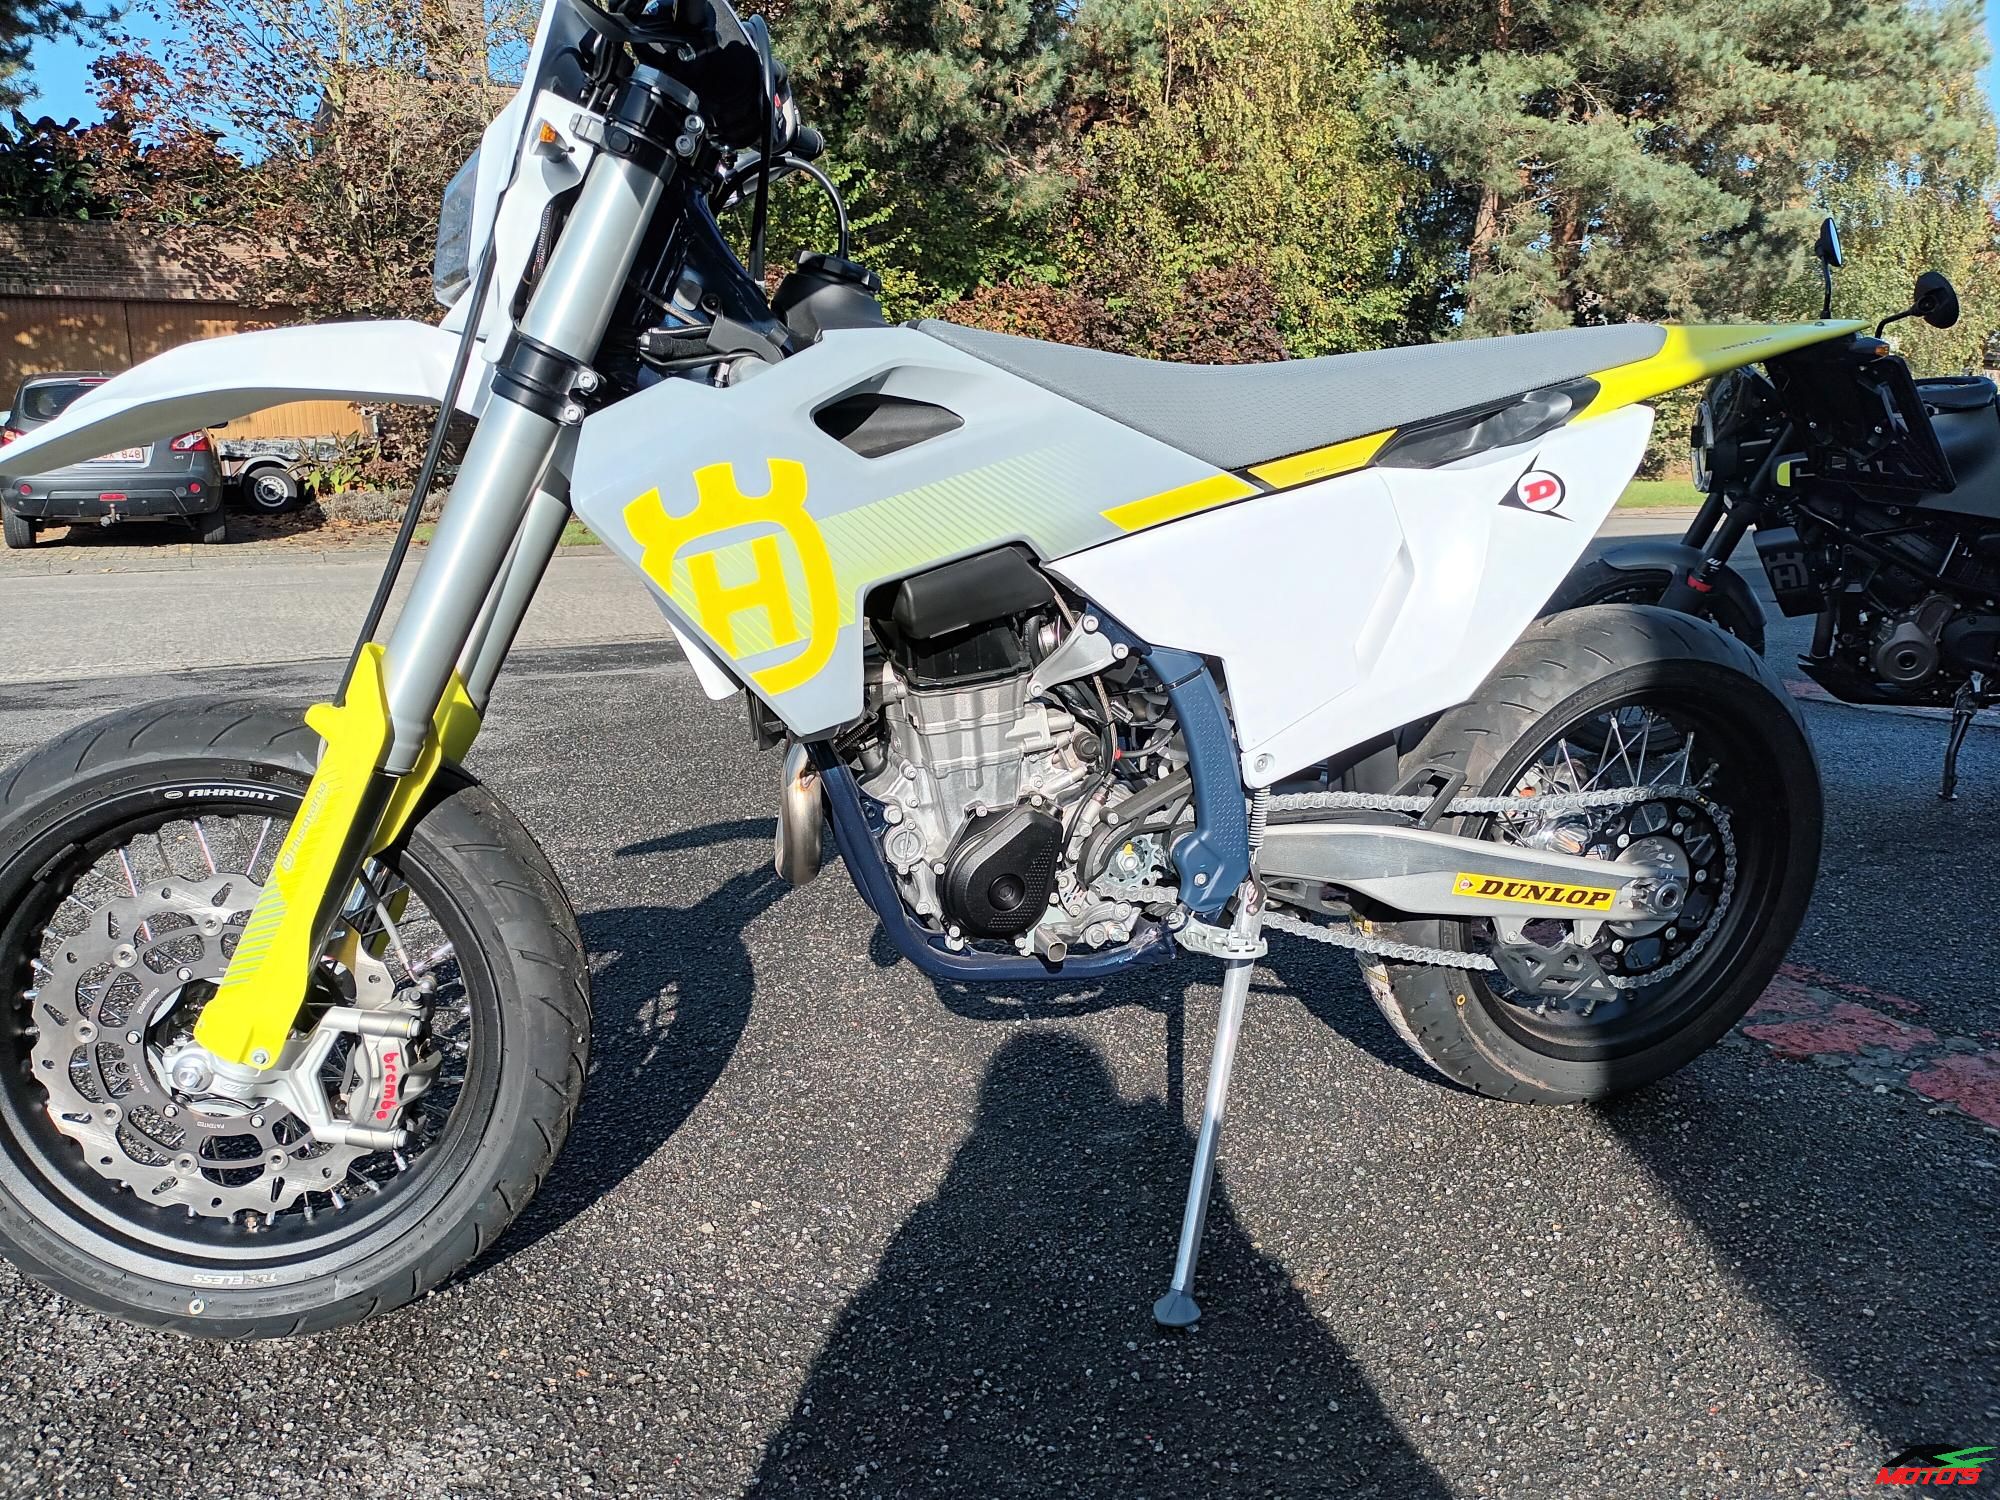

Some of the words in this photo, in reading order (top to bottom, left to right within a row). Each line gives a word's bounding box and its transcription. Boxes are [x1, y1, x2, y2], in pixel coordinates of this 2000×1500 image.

[1523, 479, 1557, 504] D
[289, 782, 328, 854] Husqvarna
[1476, 879, 1611, 907] DUNLOP
[375, 1052, 399, 1120] brembo
